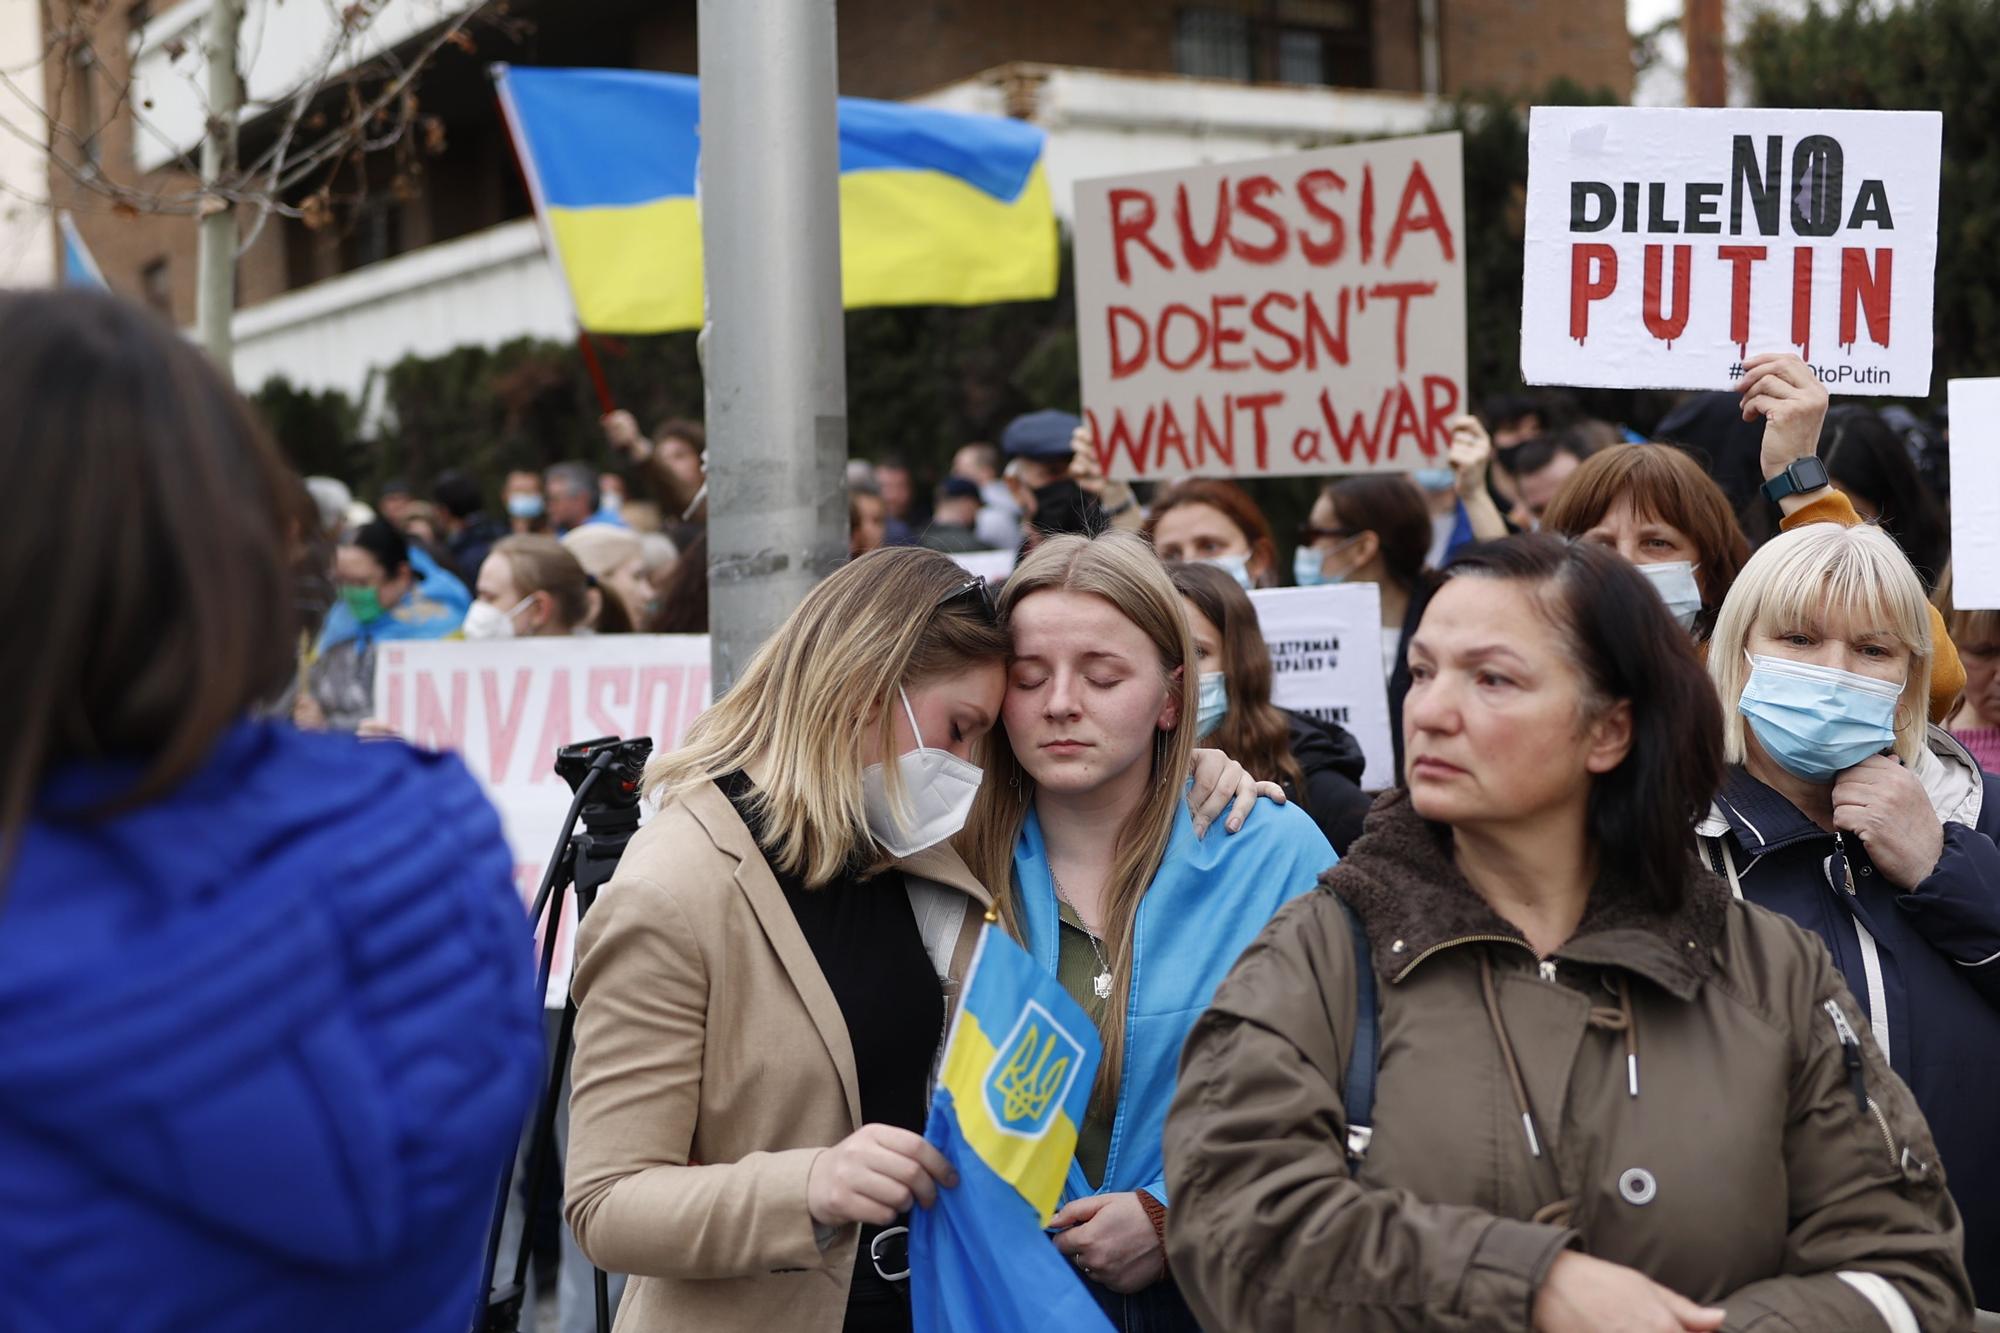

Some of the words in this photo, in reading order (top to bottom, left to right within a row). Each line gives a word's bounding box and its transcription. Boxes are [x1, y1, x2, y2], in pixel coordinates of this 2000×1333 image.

[1107, 160, 1455, 285] RUSSIA
[1107, 282, 1438, 380] DOESN'T
[1569, 243, 1892, 361] PUTIN
[1085, 392, 1286, 477] WANT
[1292, 428, 1325, 463] a
[1319, 374, 1459, 465] WAR
